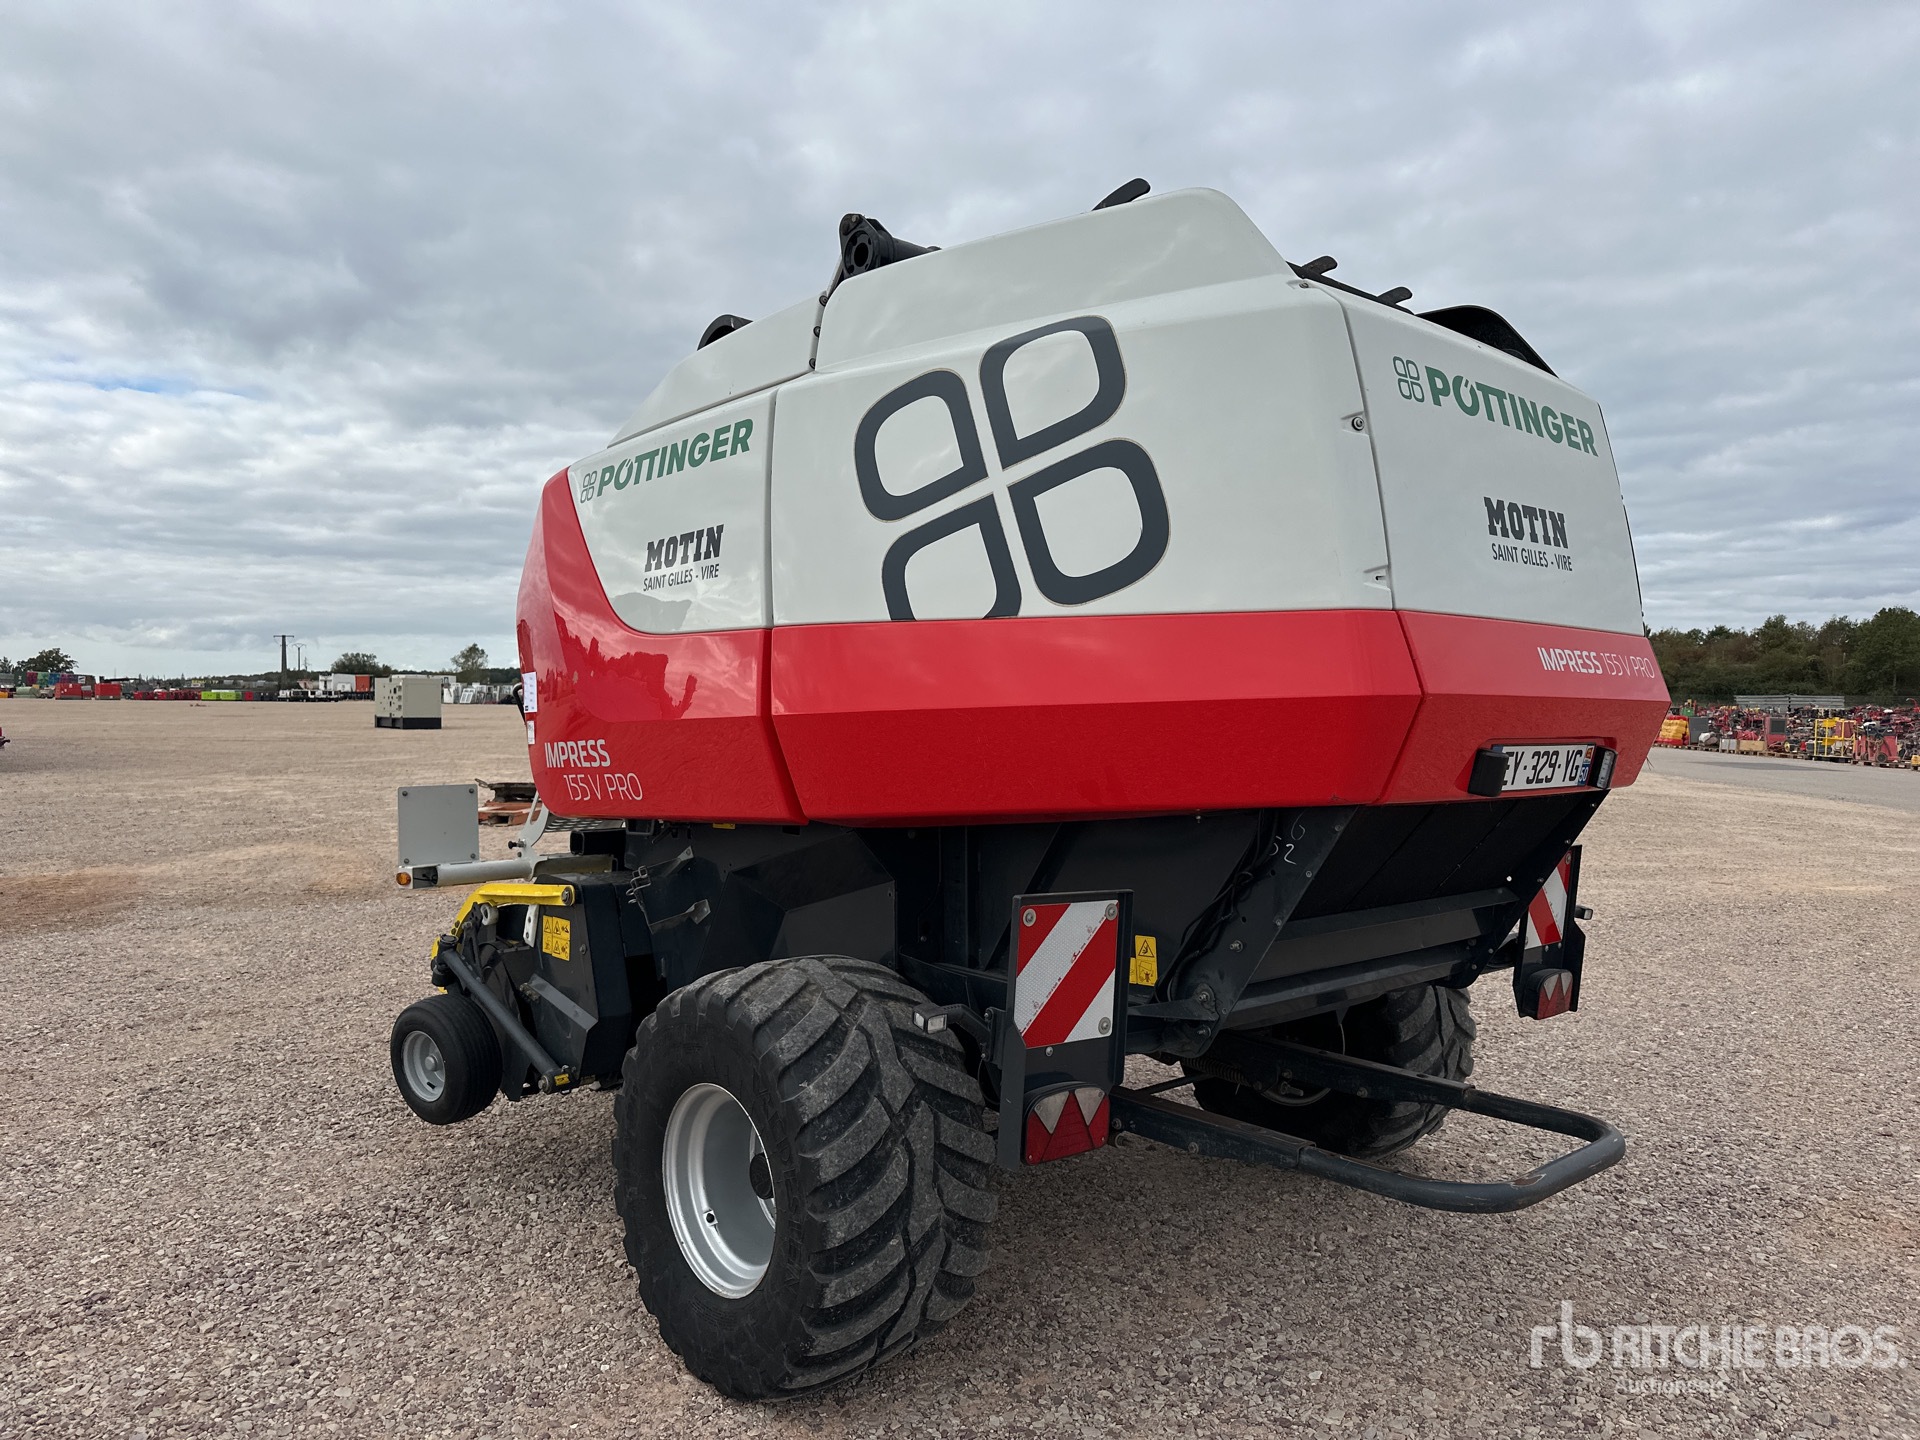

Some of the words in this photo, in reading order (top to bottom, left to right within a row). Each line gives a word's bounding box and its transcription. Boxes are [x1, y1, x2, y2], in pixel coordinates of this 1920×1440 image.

[1424, 366, 1599, 457] PÖTTINGER
[597, 418, 754, 497] PÖTTINGER
[1484, 496, 1568, 549] MOTIN
[644, 524, 724, 573] MOTIN
[1491, 542, 1519, 563] SAINT
[1520, 547, 1549, 568] GILLES
[1555, 553, 1573, 571] VIRE
[643, 574, 666, 592] SAINT
[667, 568, 693, 588] GILLES
[701, 563, 720, 580] VIRE
[1537, 647, 1603, 675] IMPRESS
[1629, 656, 1655, 679] PRO
[544, 739, 611, 768] IMPRESS
[604, 772, 643, 801] PRO
